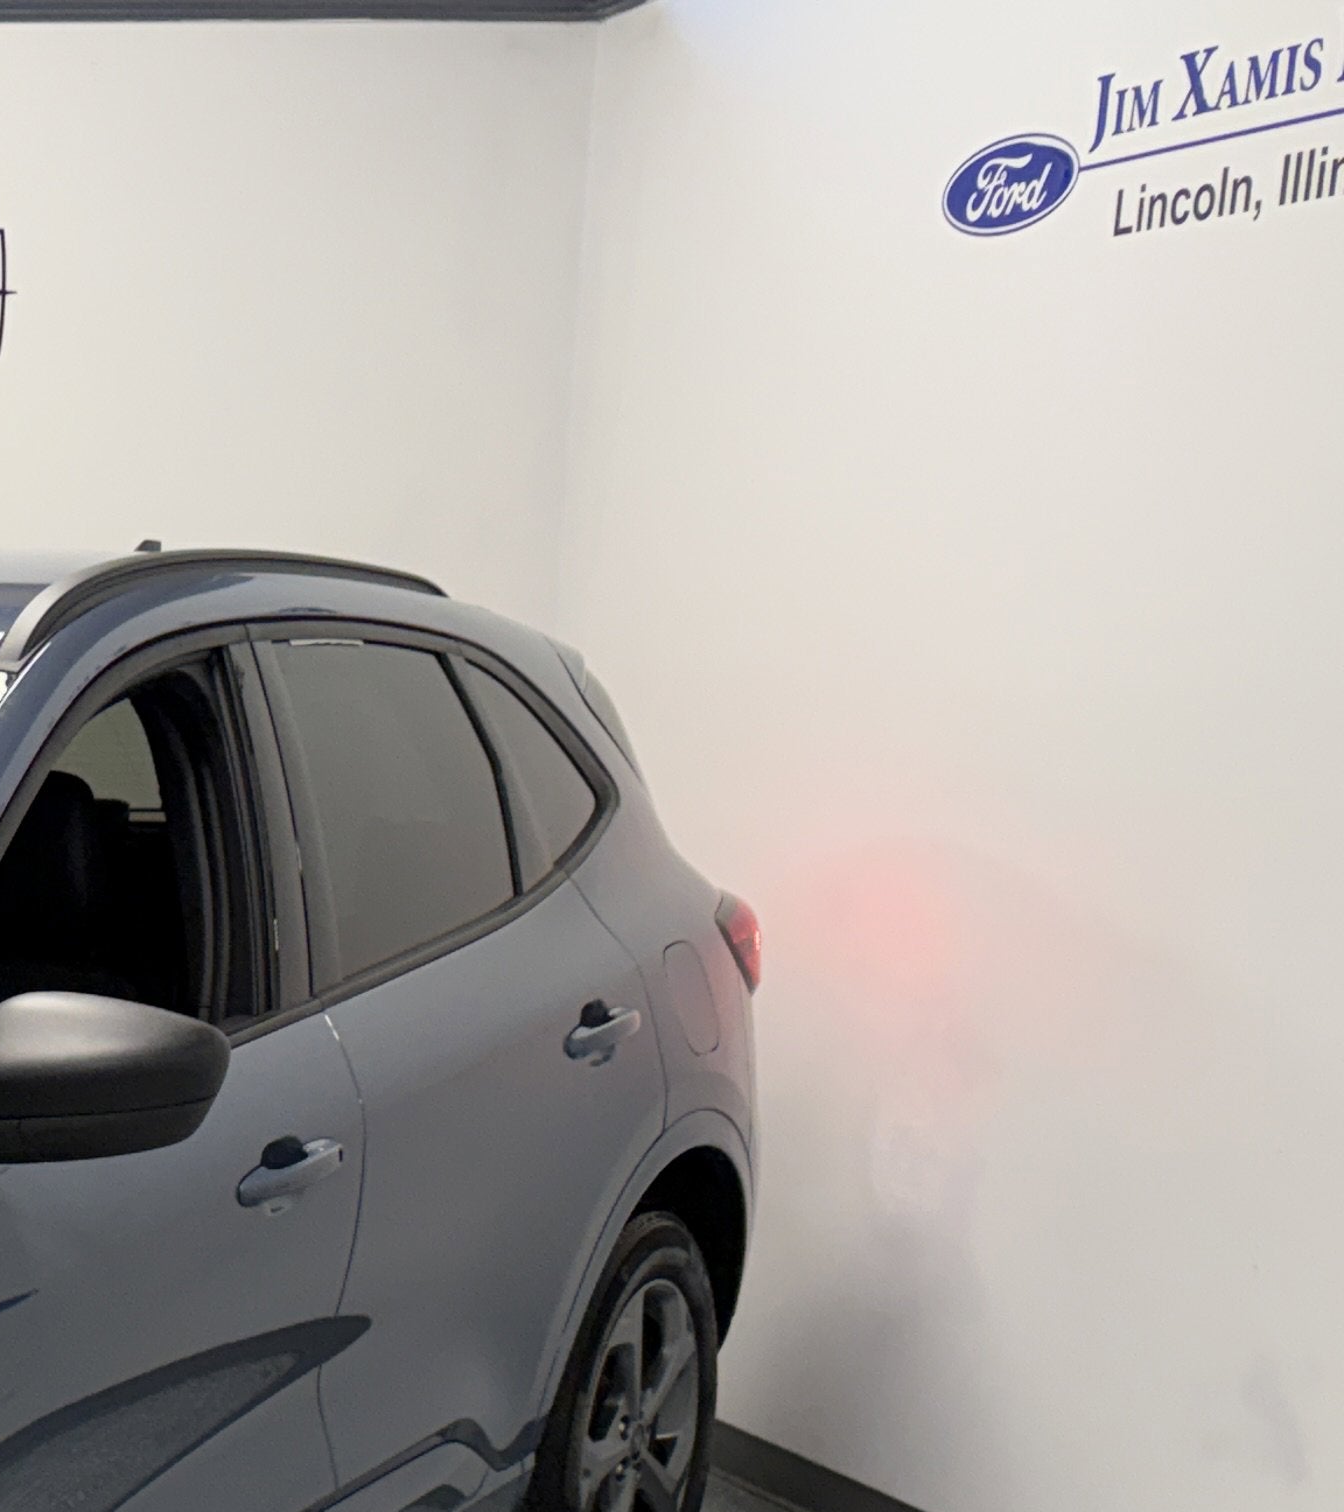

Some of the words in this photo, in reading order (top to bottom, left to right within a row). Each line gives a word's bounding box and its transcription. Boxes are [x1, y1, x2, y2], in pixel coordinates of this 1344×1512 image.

[1088, 72, 1165, 154] JIM
[1171, 37, 1325, 121] XAMIS
[966, 152, 1053, 223] Ford
[1112, 166, 1262, 237] Lincoln,
